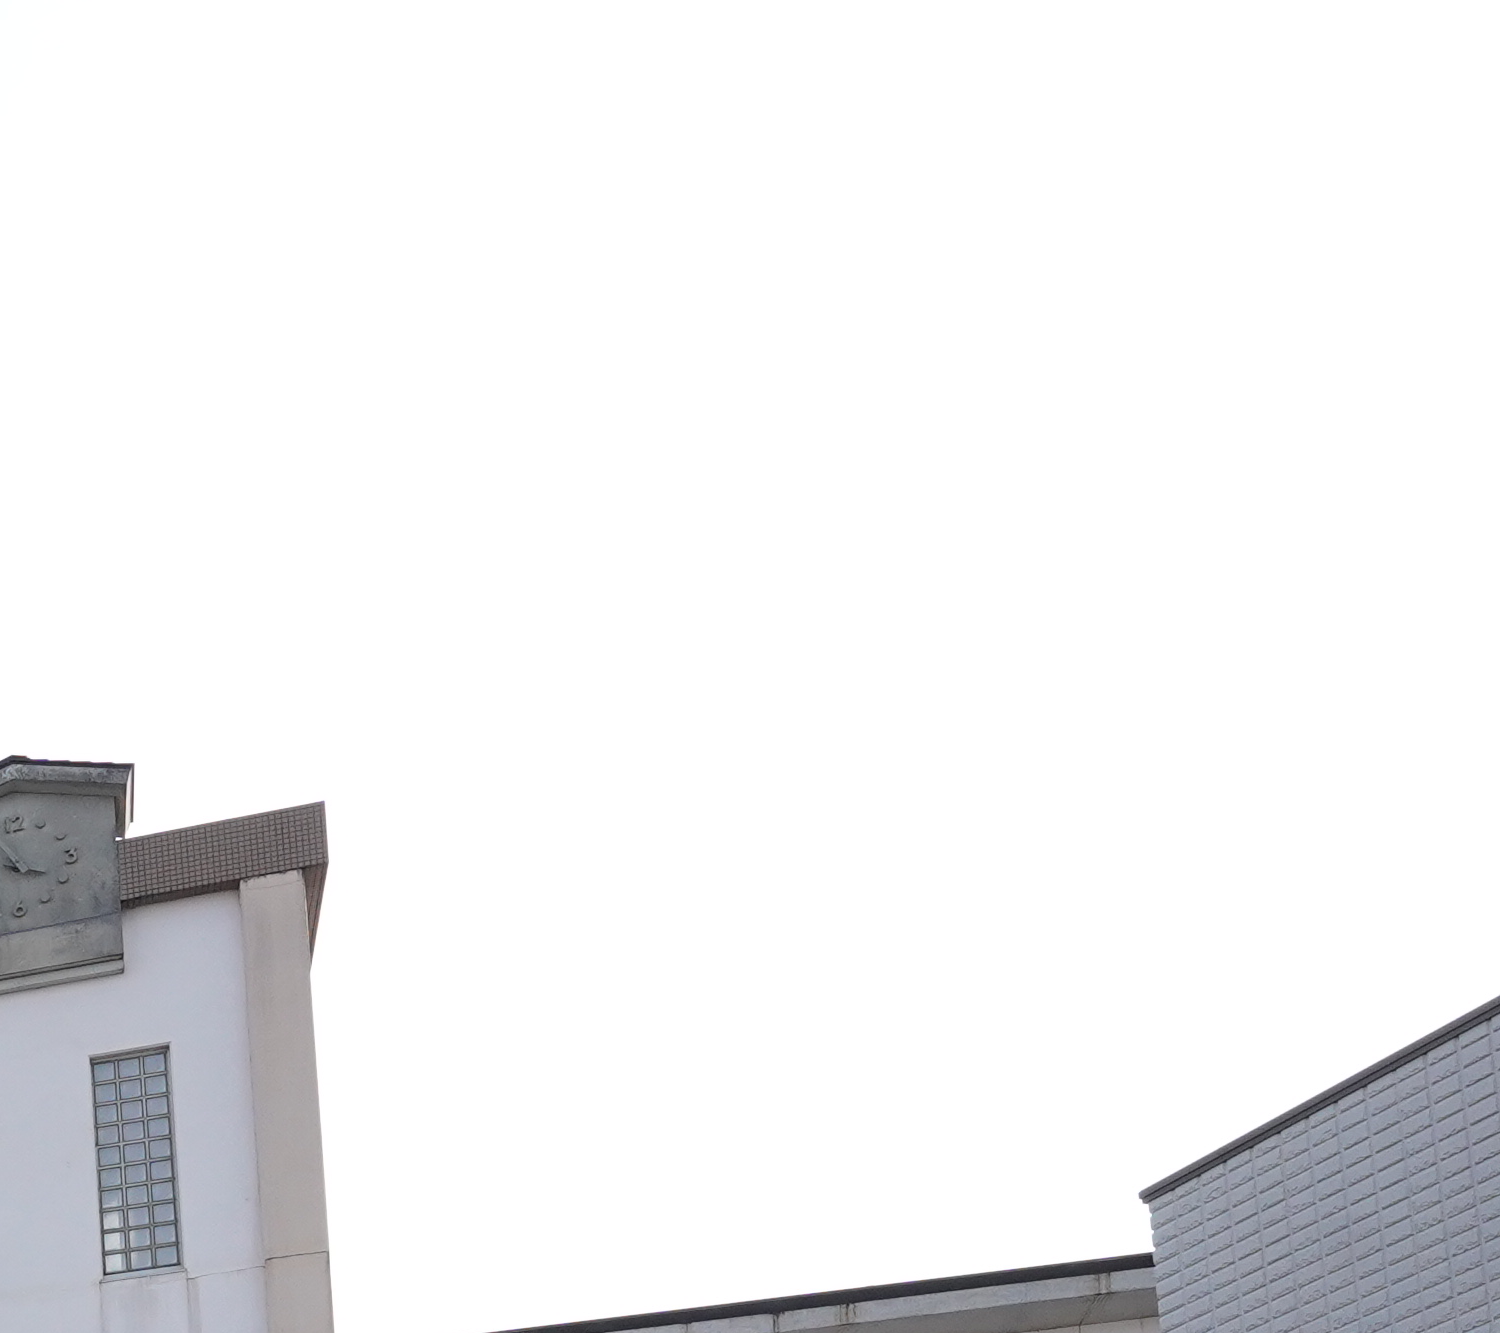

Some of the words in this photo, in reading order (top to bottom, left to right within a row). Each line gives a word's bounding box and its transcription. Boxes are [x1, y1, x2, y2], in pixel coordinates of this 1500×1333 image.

[4, 816, 26, 834] 12
[64, 847, 78, 865] 3
[12, 900, 28, 918] 6
